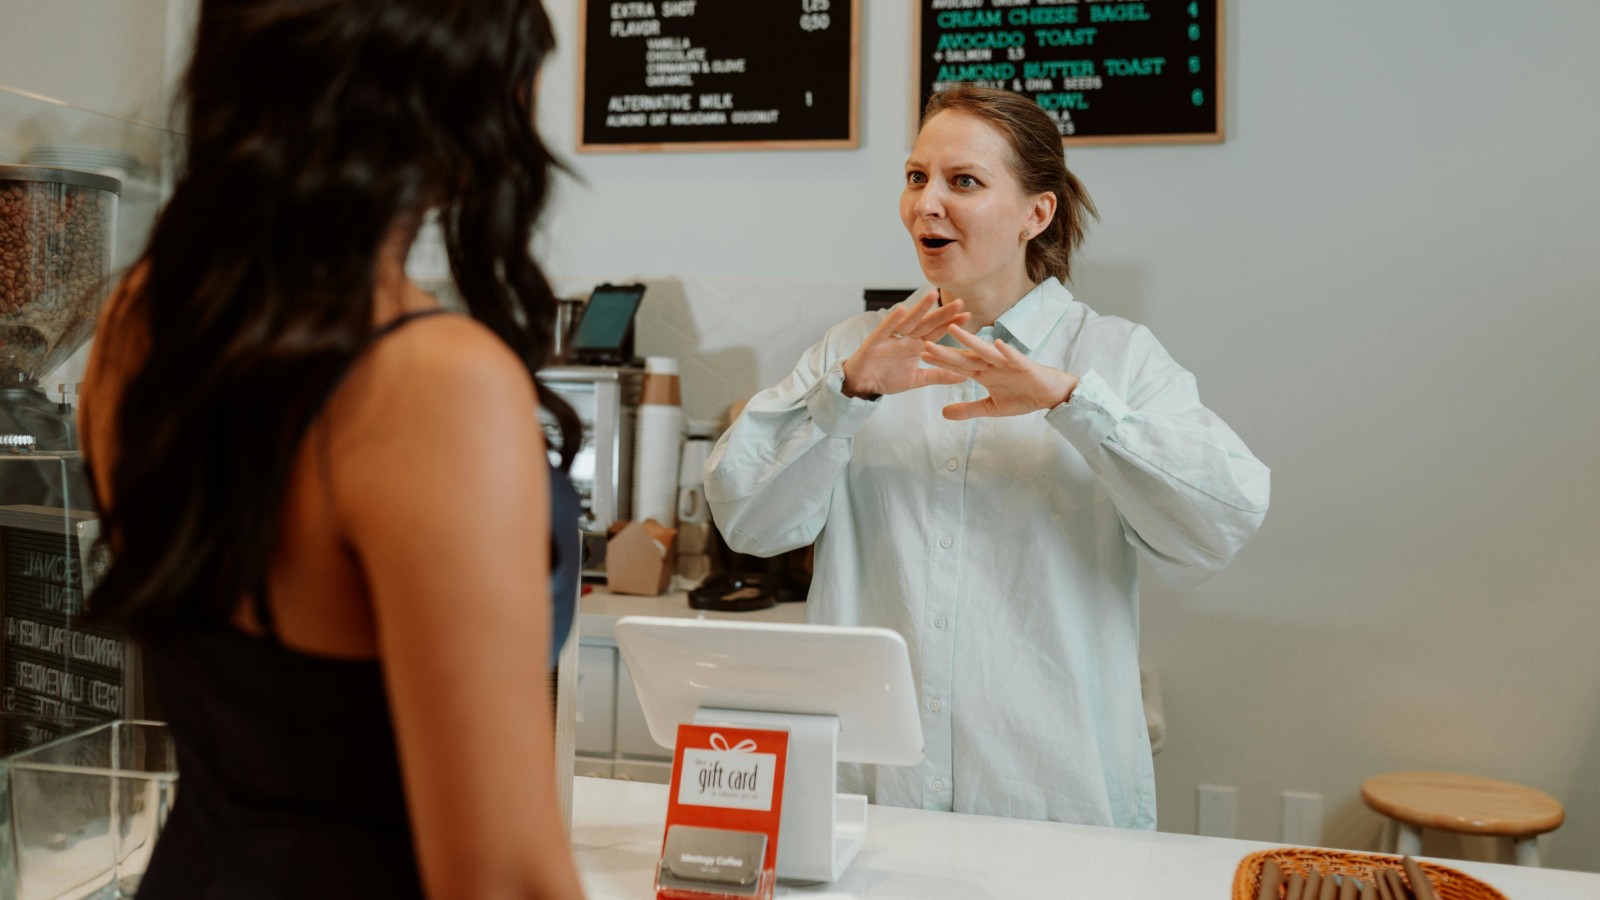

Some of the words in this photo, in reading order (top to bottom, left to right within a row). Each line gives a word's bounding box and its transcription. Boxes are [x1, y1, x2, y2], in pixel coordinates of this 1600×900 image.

[611, 2, 655, 19] EXTRA
[662, 0, 696, 17] SHOT
[937, 10, 1002, 28] CREAM
[1008, 7, 1077, 25] CHEESE
[1090, 3, 1150, 22] BAGEL
[1187, 1, 1199, 18] 4
[611, 20, 660, 37] FLAVOR
[646, 38, 690, 49] VANILLA
[938, 31, 1025, 50] AVOCADO
[1035, 28, 1097, 46] TOAST
[646, 48, 706, 61] CHOCOLATE
[946, 48, 992, 62] SALMON
[646, 62, 700, 74] CINNAMON
[711, 59, 745, 73] CLOVE
[937, 64, 1016, 80] ALMOND
[1024, 60, 1096, 78] BUTTER
[1104, 57, 1165, 76] TOAST
[646, 75, 694, 87] CARAMEL
[1064, 76, 1102, 90] SEEDS
[608, 94, 691, 112] ALTERNATIVE
[700, 94, 733, 109] MILK
[805, 92, 812, 106] 1
[1036, 93, 1088, 110] BOWL
[606, 114, 647, 127] ALMOND
[649, 113, 668, 126] OAT
[670, 112, 726, 125] MACADAMIA
[731, 110, 778, 124] COCONUT
[698, 759, 724, 794] gift
[728, 764, 758, 792] card
[716, 856, 744, 868] Coffee
